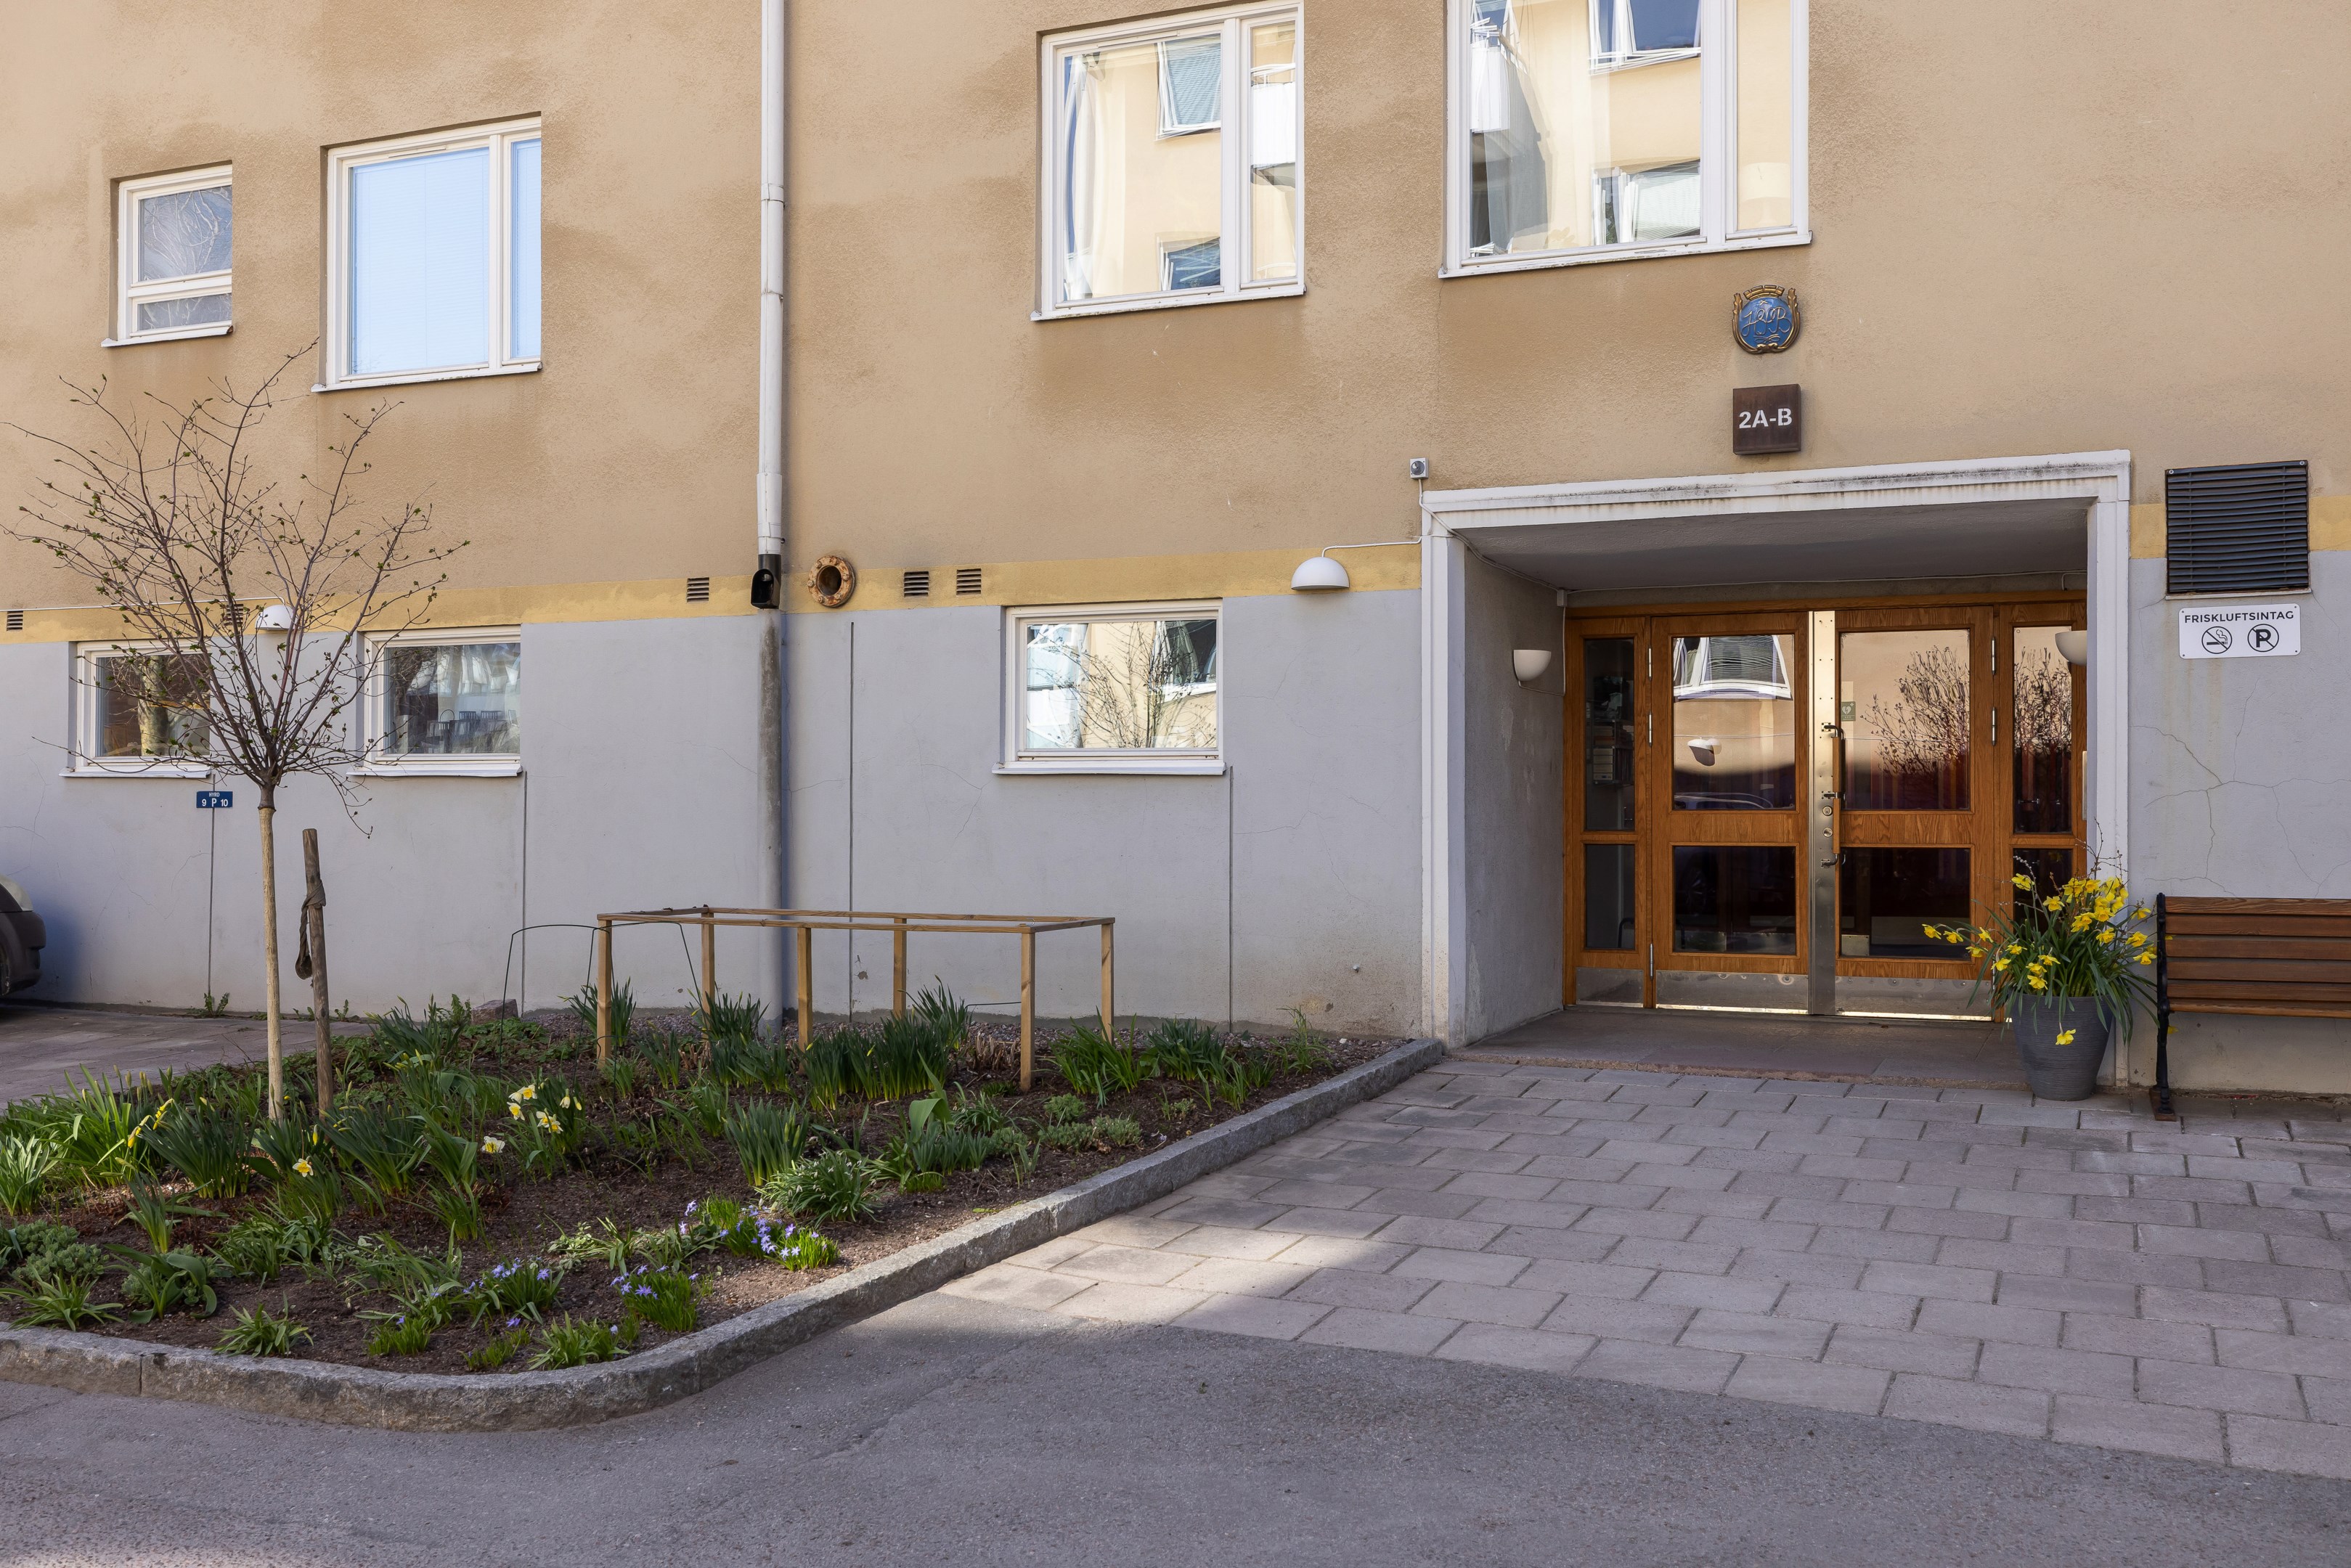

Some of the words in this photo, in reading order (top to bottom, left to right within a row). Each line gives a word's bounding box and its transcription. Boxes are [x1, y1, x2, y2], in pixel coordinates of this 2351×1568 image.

[1738, 408, 1793, 429] 2A-B
[2184, 611, 2294, 624] FRISKLUFTSINTAG
[211, 798, 217, 807] P
[220, 799, 229, 807] 10
